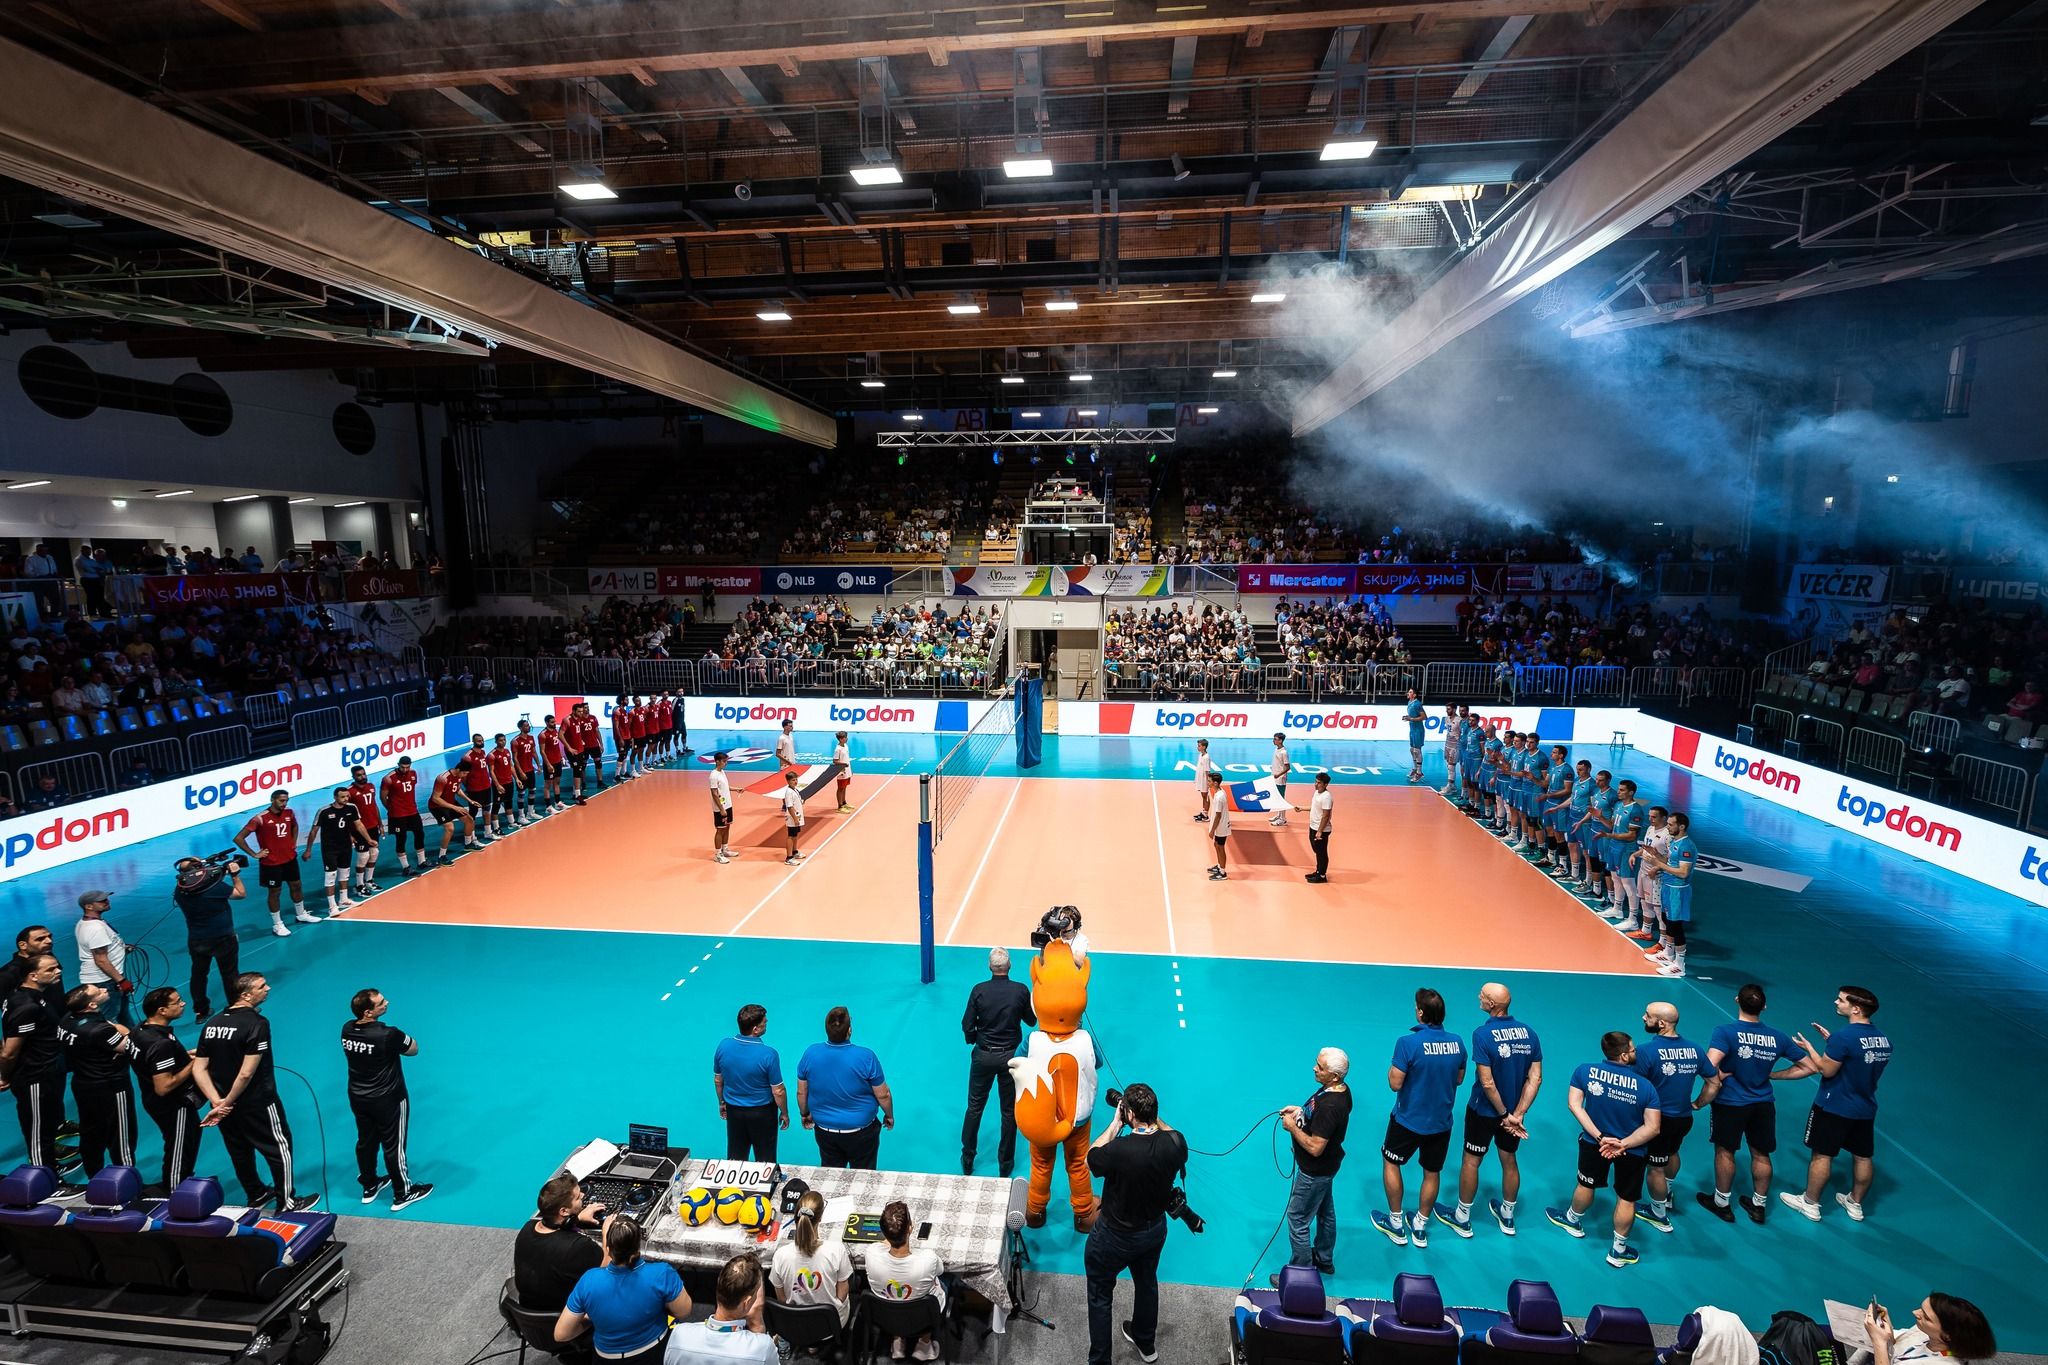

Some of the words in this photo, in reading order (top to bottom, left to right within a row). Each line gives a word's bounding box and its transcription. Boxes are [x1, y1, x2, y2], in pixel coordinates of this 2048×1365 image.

[795, 576, 815, 585] NLB
[856, 576, 876, 585] NLB
[1270, 574, 1345, 587] Mercator
[1363, 575, 1421, 586] SKUPINA
[1425, 574, 1466, 586] JHMB
[1800, 568, 1873, 598] VEČER
[157, 586, 230, 603] SKUPINA
[234, 585, 278, 600] JHMB
[714, 702, 797, 724] topdom
[829, 703, 915, 725] topdom
[1155, 708, 1248, 730] topdom
[584, 723, 593, 731] 23
[1283, 710, 1378, 732] topdom
[341, 732, 426, 768] topdom
[523, 743, 532, 753] 22
[1715, 745, 1800, 795] topdom
[185, 763, 303, 810] topdom
[402, 781, 412, 793] 13
[452, 783, 458, 793] 5
[362, 793, 372, 805] 17
[338, 818, 345, 828] 6
[1836, 785, 1962, 852] topdom
[275, 823, 288, 836] 12
[0, 808, 130, 868] pdom
[205, 1026, 237, 1040] EGYPT
[1491, 1027, 1529, 1041] SLOVENIA
[1737, 1031, 1777, 1048] SLOVENIA
[341, 1039, 375, 1054] EGYPT
[1423, 1042, 1460, 1055] SLOVENIA
[1859, 1036, 1890, 1049] SLOVENIA
[1658, 1048, 1698, 1060] SLOVENIA
[1589, 1067, 1638, 1091] SLOVENIA
[1607, 1087, 1637, 1100] Telekom
[1607, 1093, 1637, 1105] Slovenije
[1466, 1142, 1486, 1153] nine
